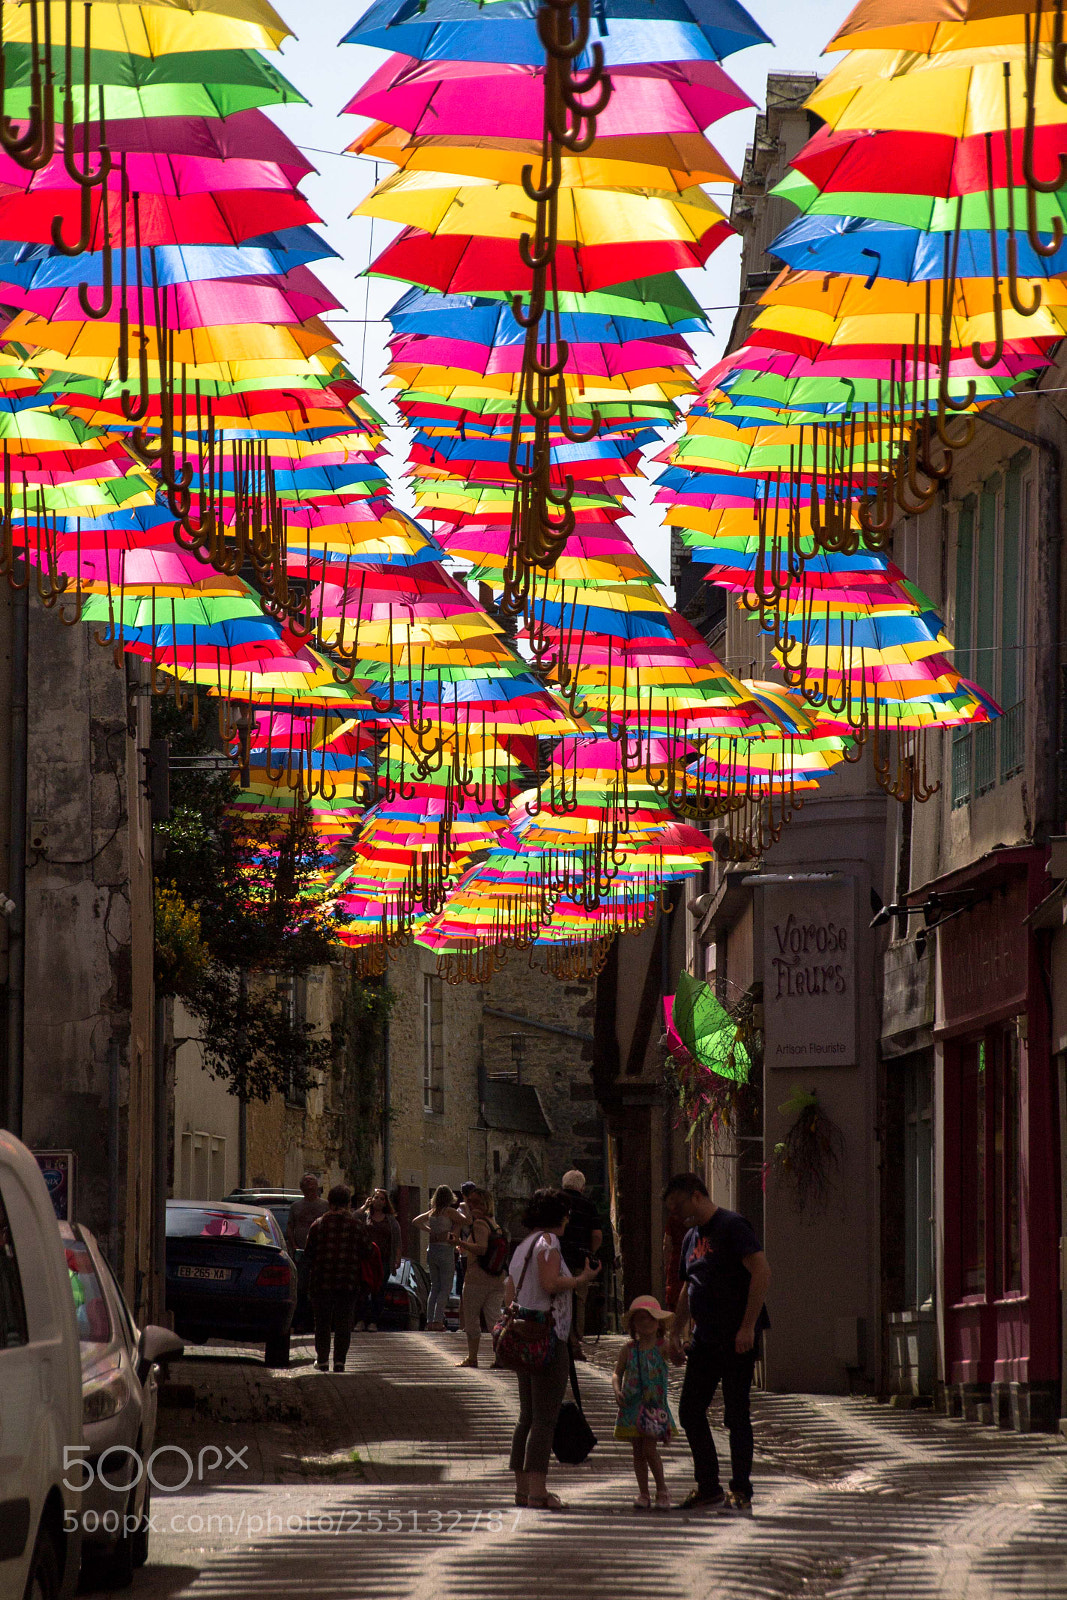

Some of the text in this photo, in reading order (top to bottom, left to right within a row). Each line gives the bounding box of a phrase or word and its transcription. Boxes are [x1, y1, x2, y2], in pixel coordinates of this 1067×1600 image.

[773, 913, 847, 955] Vorose
[771, 955, 847, 1001] Fleurs
[775, 1042, 847, 1055] Artisan Fleuriste
